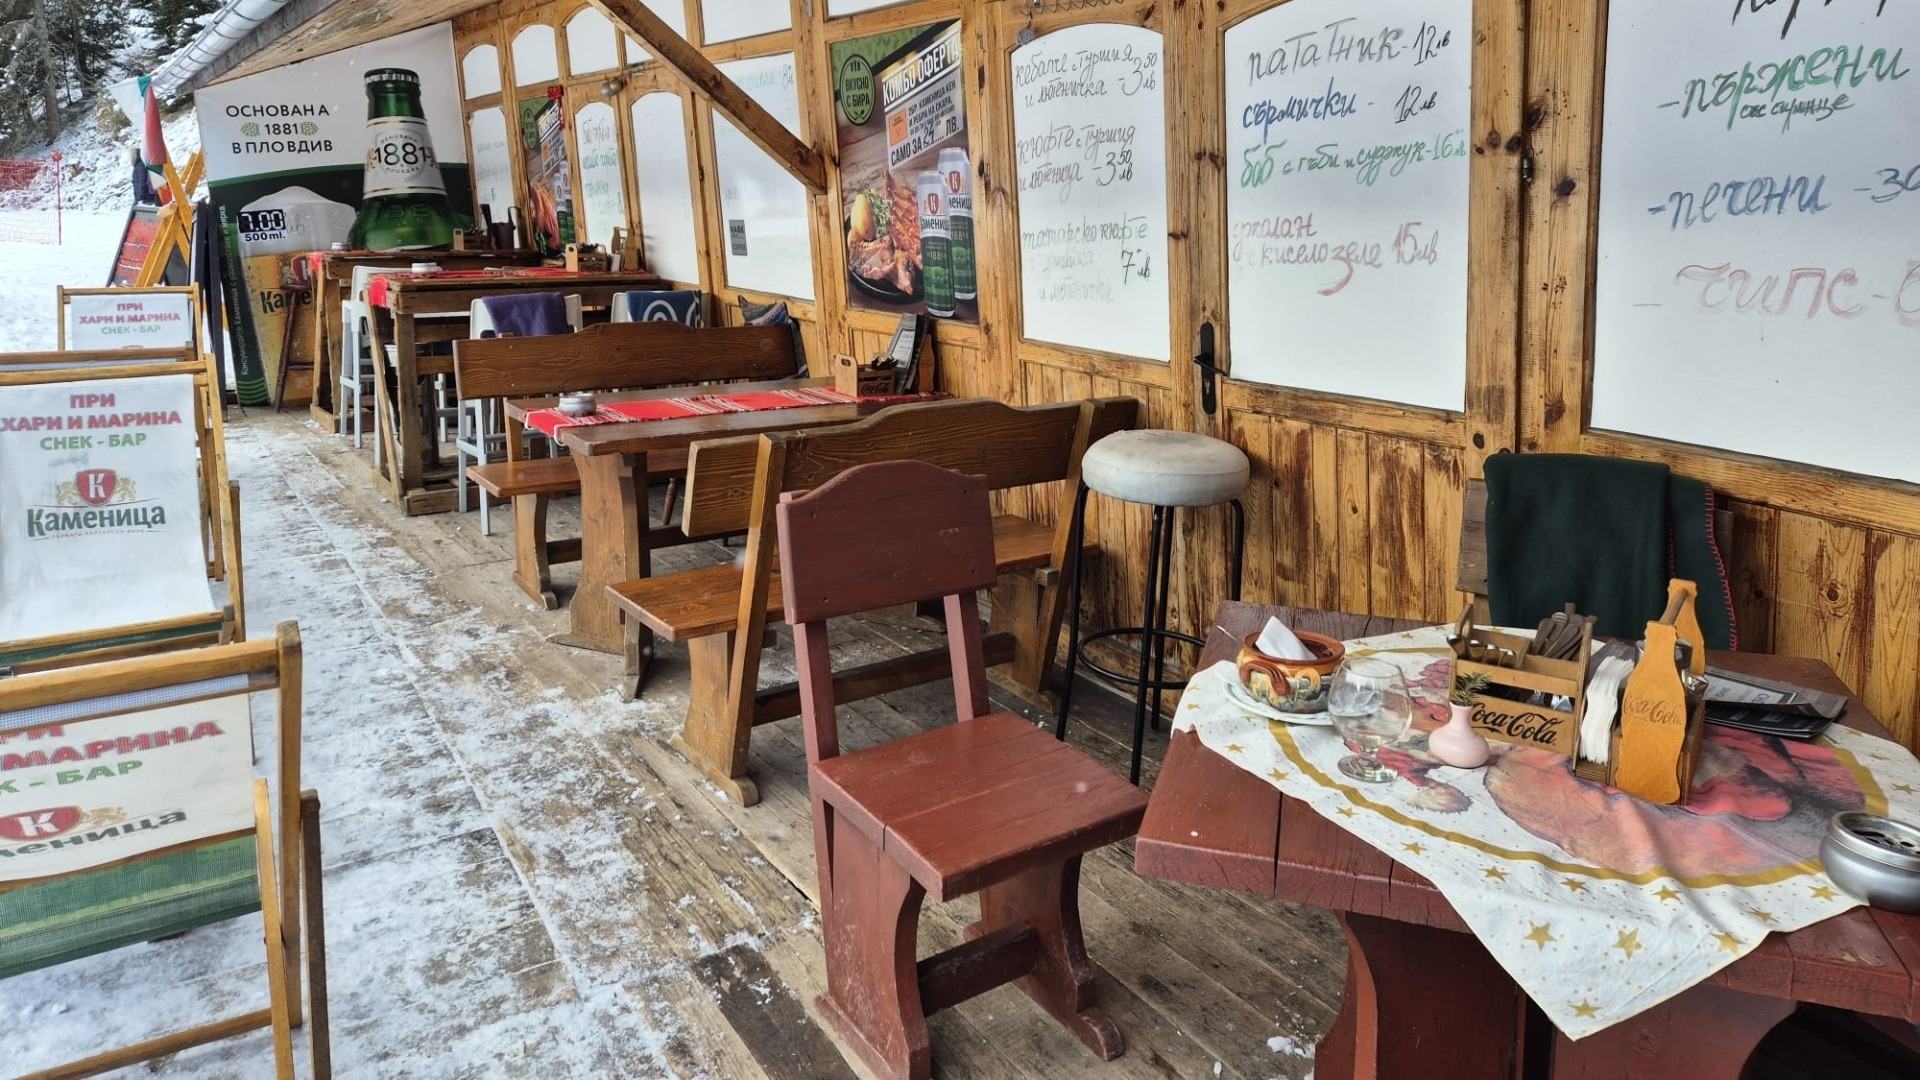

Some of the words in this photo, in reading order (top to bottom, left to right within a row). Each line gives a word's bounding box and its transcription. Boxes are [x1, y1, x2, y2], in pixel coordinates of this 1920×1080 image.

[883, 66, 916, 107] КОМБО
[917, 39, 960, 81] ОФЕРТА
[846, 76, 869, 91] ВКУСНО
[847, 95, 851, 107] С
[852, 93, 870, 107] БИРА
[919, 86, 946, 109] КАМЕНИЦА
[945, 81, 956, 93] КЕН
[1395, 85, 1421, 124] 12
[226, 104, 330, 118] ОСНОВАНА
[264, 123, 299, 136] 1881
[380, 134, 417, 144] ОСНОВАНА
[232, 142, 242, 154] В
[245, 140, 333, 154] ПЛОВДИВ
[374, 142, 427, 166] 1881
[891, 141, 912, 166] САМО
[911, 136, 923, 155] ЗА
[384, 165, 419, 174] ПЛОВДИВ
[241, 211, 284, 232] 7.00
[117, 303, 143, 311] ПРИ
[80, 315, 113, 325] ХАРИ
[116, 315, 125, 323] И
[127, 312, 181, 323] МАРИНА
[101, 326, 131, 335] СНЕК
[139, 325, 161, 333] БАР
[70, 393, 116, 409] ПРИ
[0, 416, 63, 432] ХАРИ
[68, 416, 83, 430] И
[88, 411, 182, 429] МАРИНА
[40, 435, 93, 451] СНЕК
[109, 432, 147, 448] БАР
[88, 472, 106, 499] К
[27, 505, 166, 538] Каменица
[1, 721, 226, 771] МАРИНА
[57, 760, 144, 786] БАР
[17, 811, 60, 837] К
